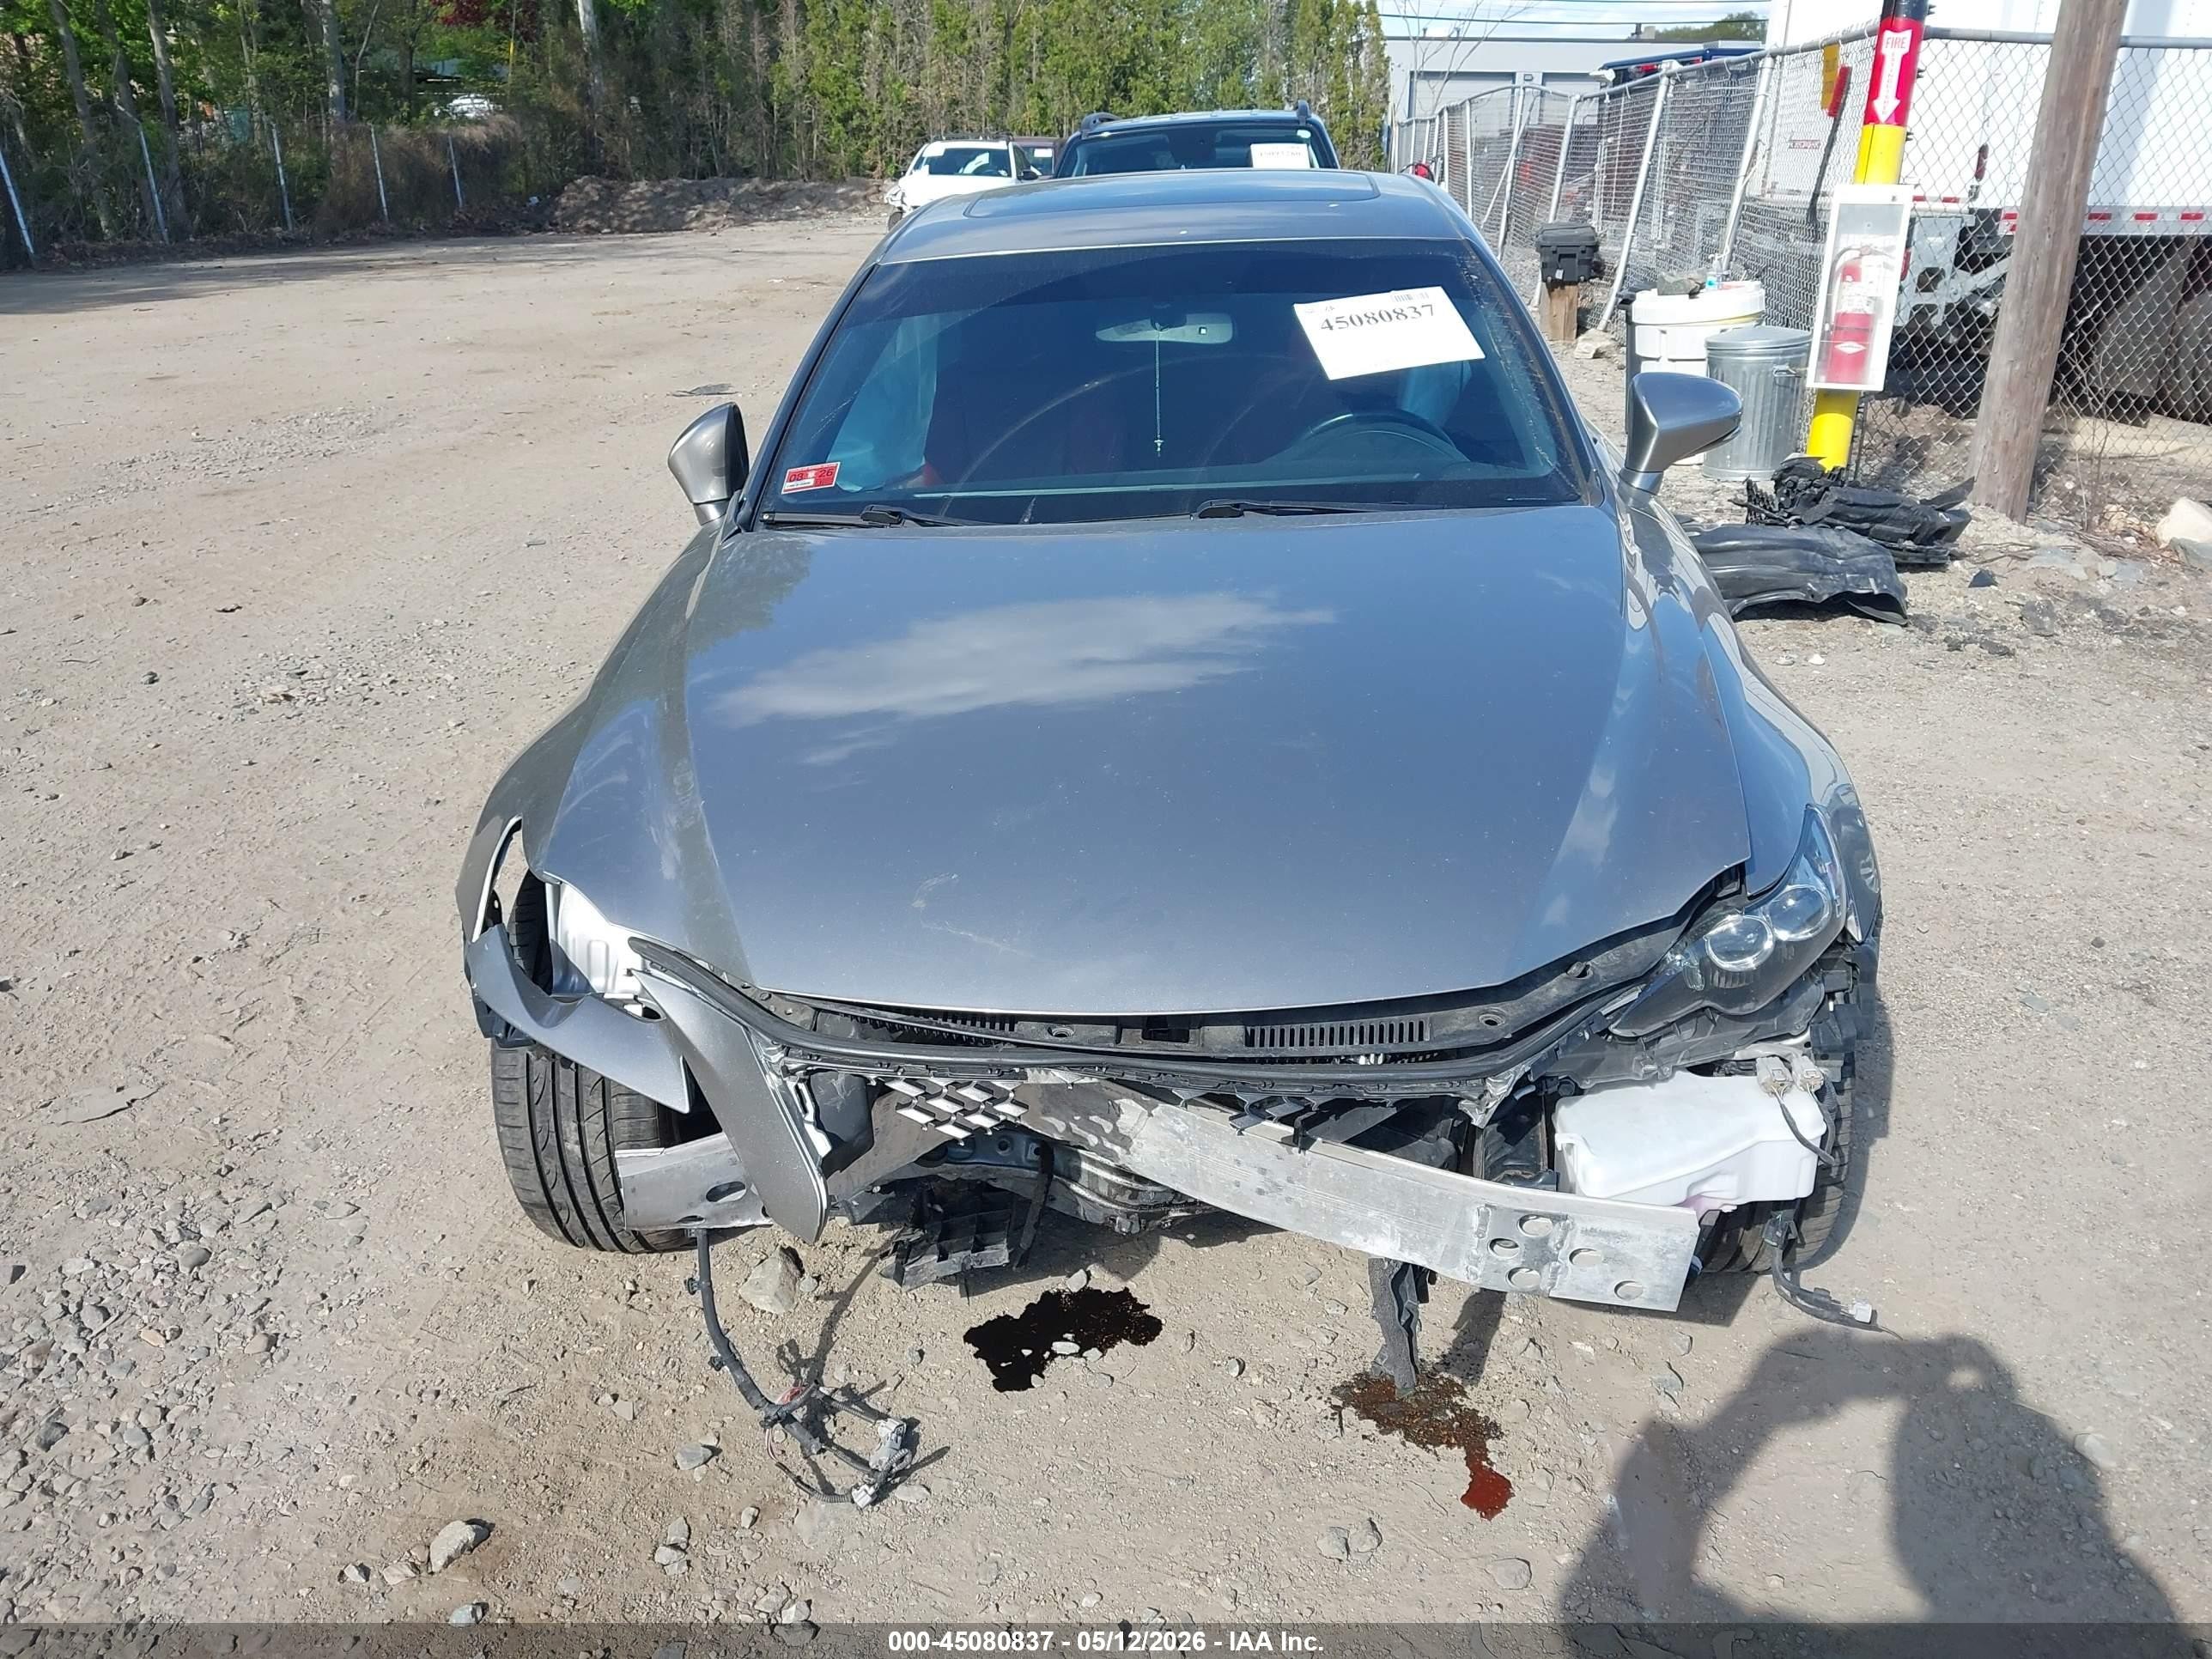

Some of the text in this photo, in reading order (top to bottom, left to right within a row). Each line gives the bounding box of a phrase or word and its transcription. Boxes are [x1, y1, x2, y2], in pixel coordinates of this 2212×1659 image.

[1885, 37, 1907, 49] FIRE
[1320, 304, 1434, 331] 45080837
[818, 468, 834, 477] 26
